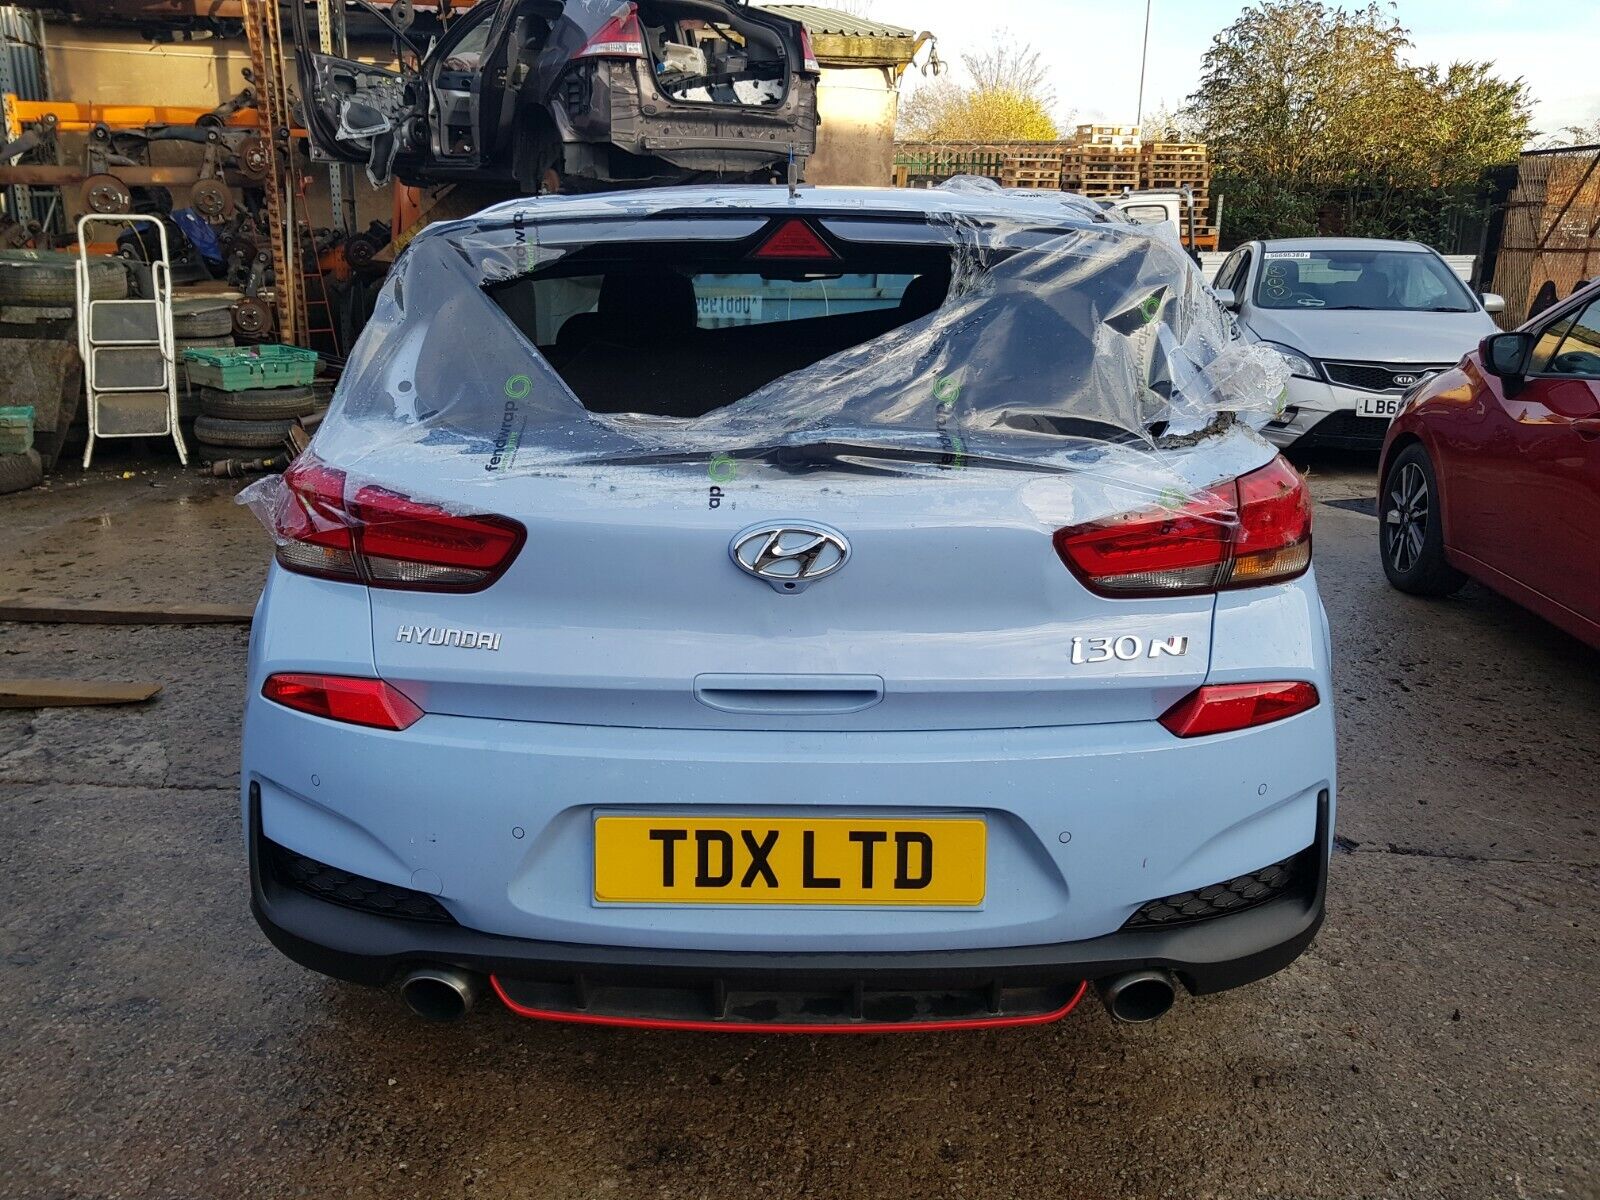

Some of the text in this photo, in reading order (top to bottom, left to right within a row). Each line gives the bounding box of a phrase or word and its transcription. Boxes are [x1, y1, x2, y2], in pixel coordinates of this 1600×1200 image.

[1364, 400, 1397, 415] LB6
[485, 401, 519, 472] fendwrap
[396, 624, 502, 651] HYUNDAI
[1071, 635, 1188, 664] i30 N
[649, 829, 933, 889] TDX LTD
